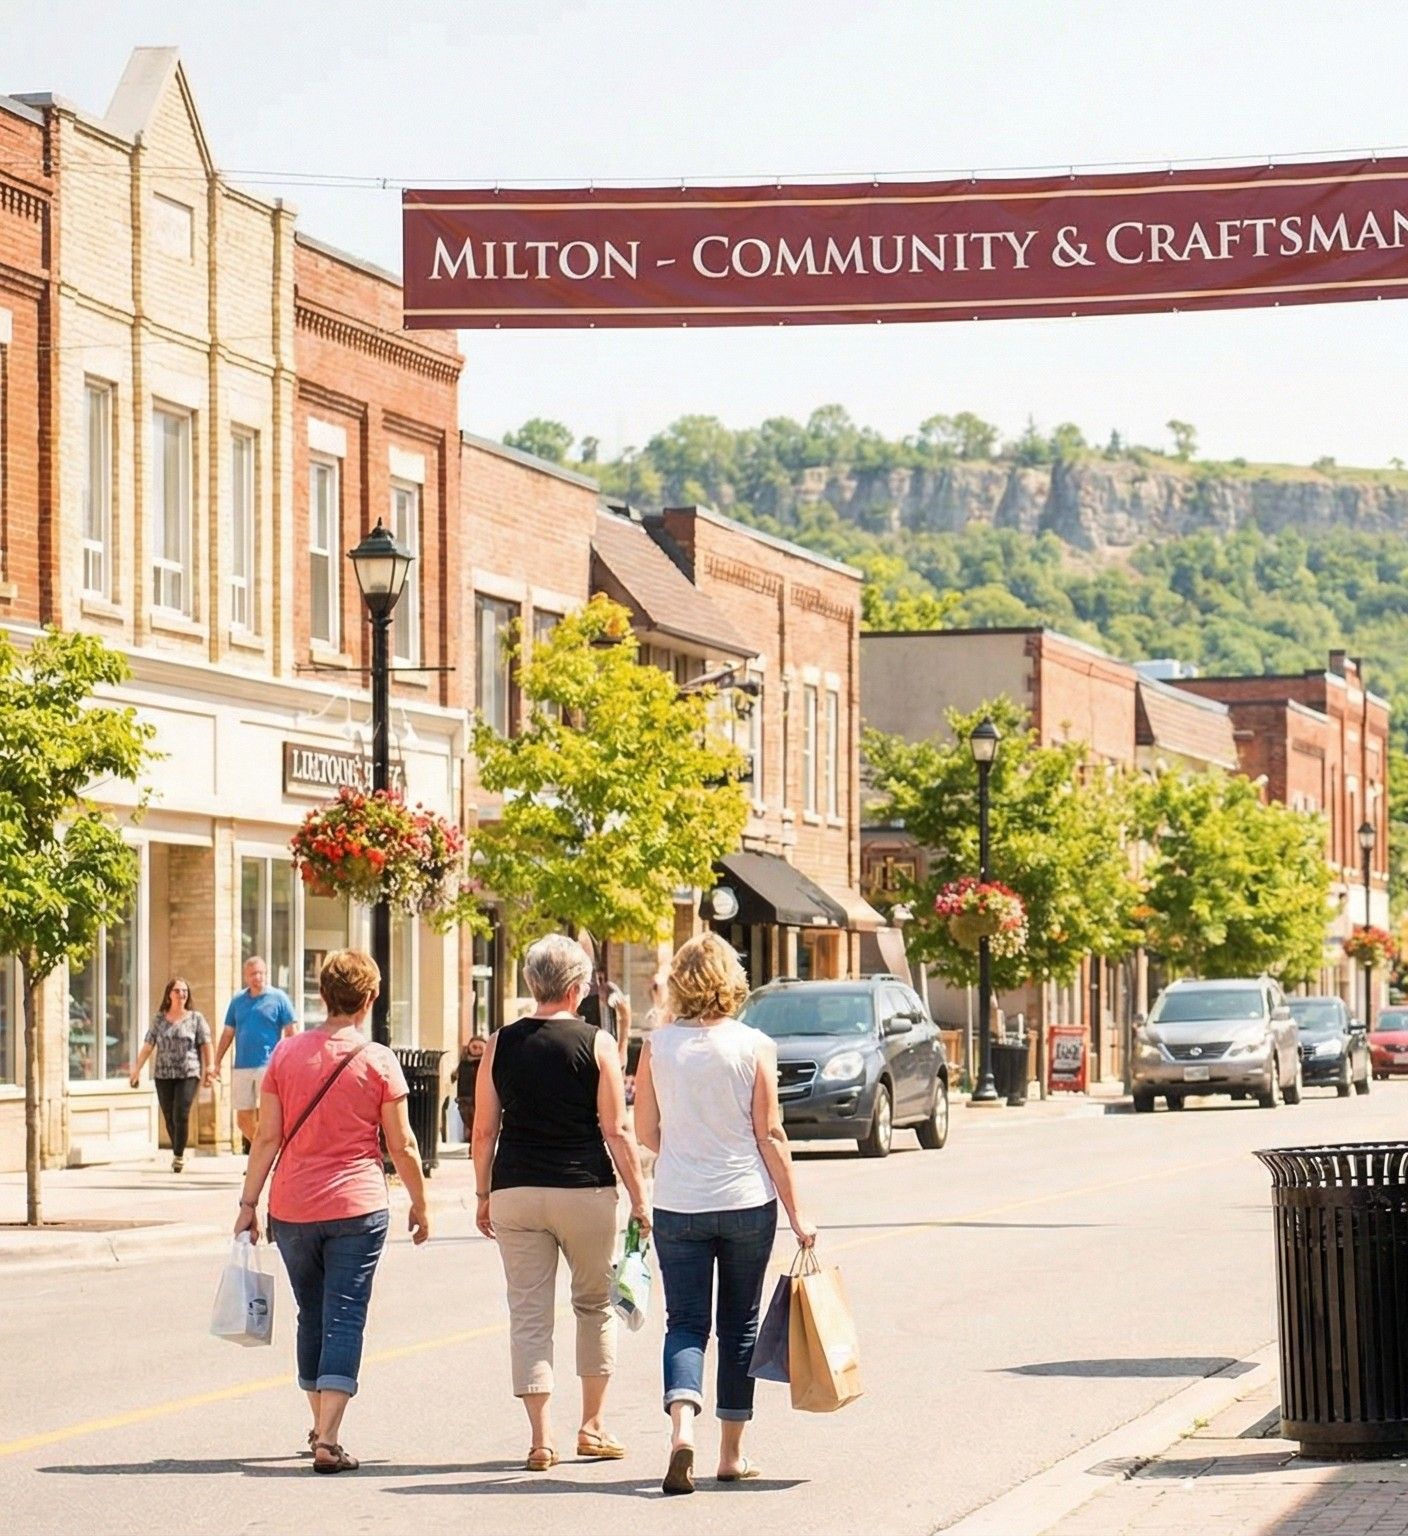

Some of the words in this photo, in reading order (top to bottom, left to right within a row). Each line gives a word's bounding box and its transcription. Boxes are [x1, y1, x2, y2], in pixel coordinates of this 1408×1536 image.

[429, 236, 641, 280] MILTON
[692, 228, 1038, 279] COMMUNITY
[1051, 225, 1096, 269] &
